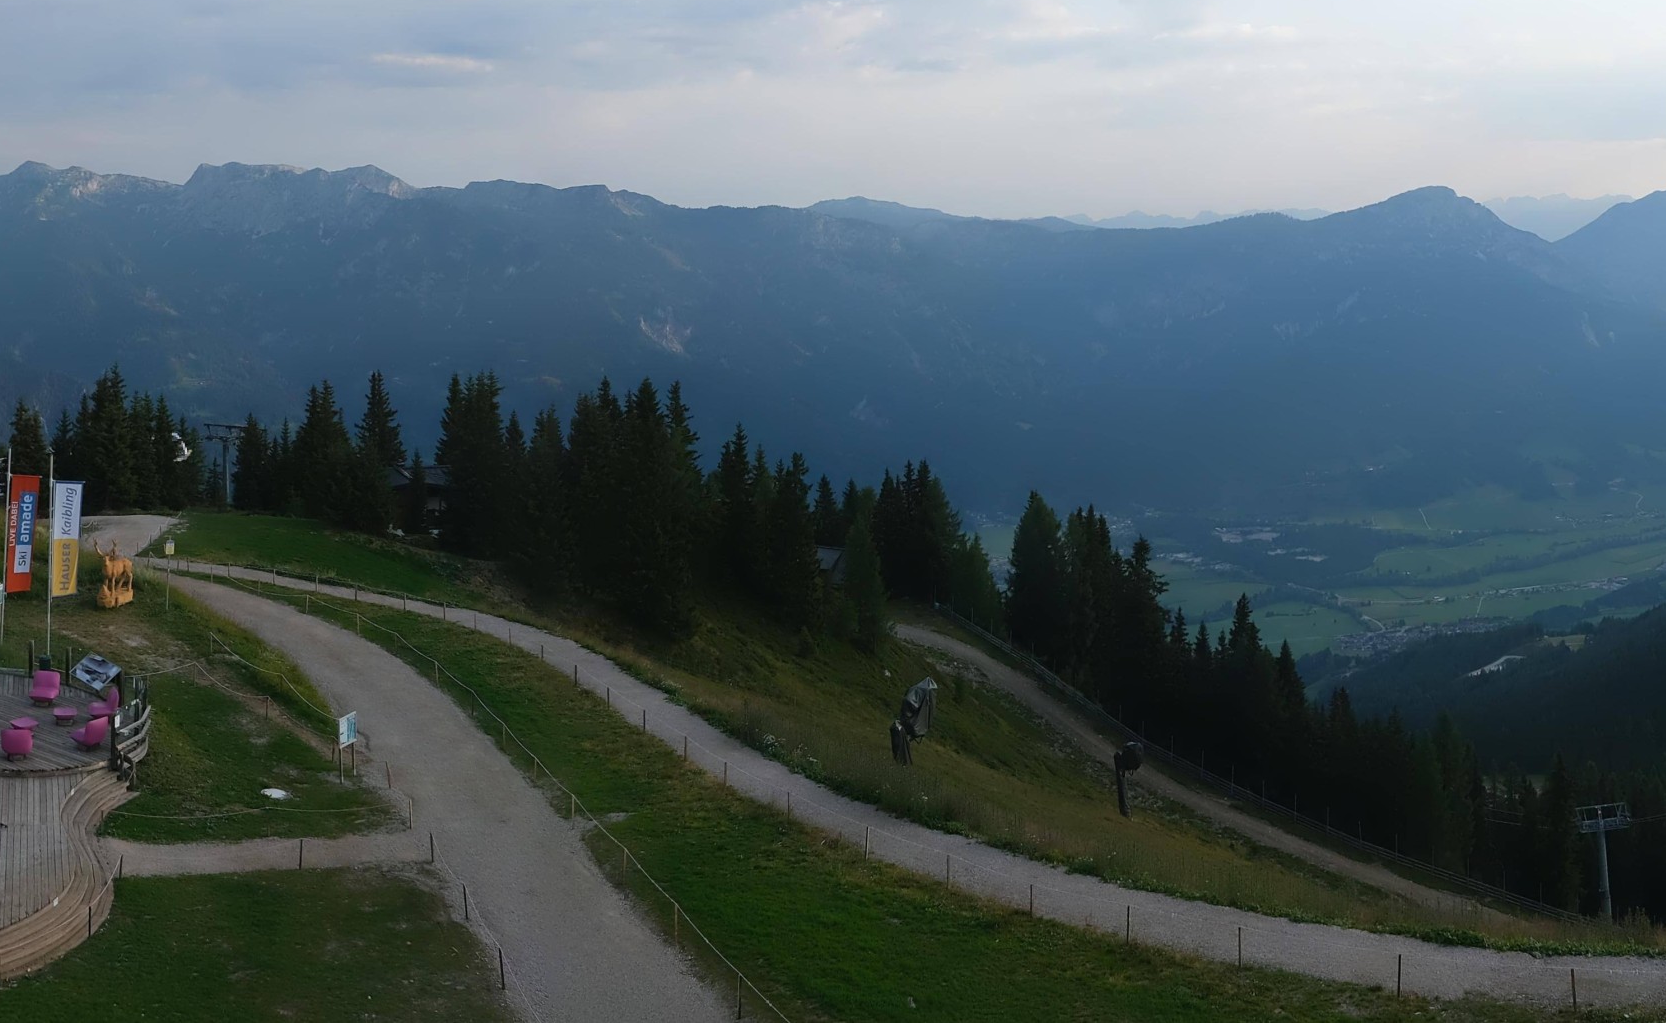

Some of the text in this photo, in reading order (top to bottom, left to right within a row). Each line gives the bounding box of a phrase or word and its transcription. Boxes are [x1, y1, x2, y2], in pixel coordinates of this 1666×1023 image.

[10, 501, 19, 526] DABEI
[59, 487, 78, 591] HAUSER Kaibling
[18, 551, 27, 567] Ski
